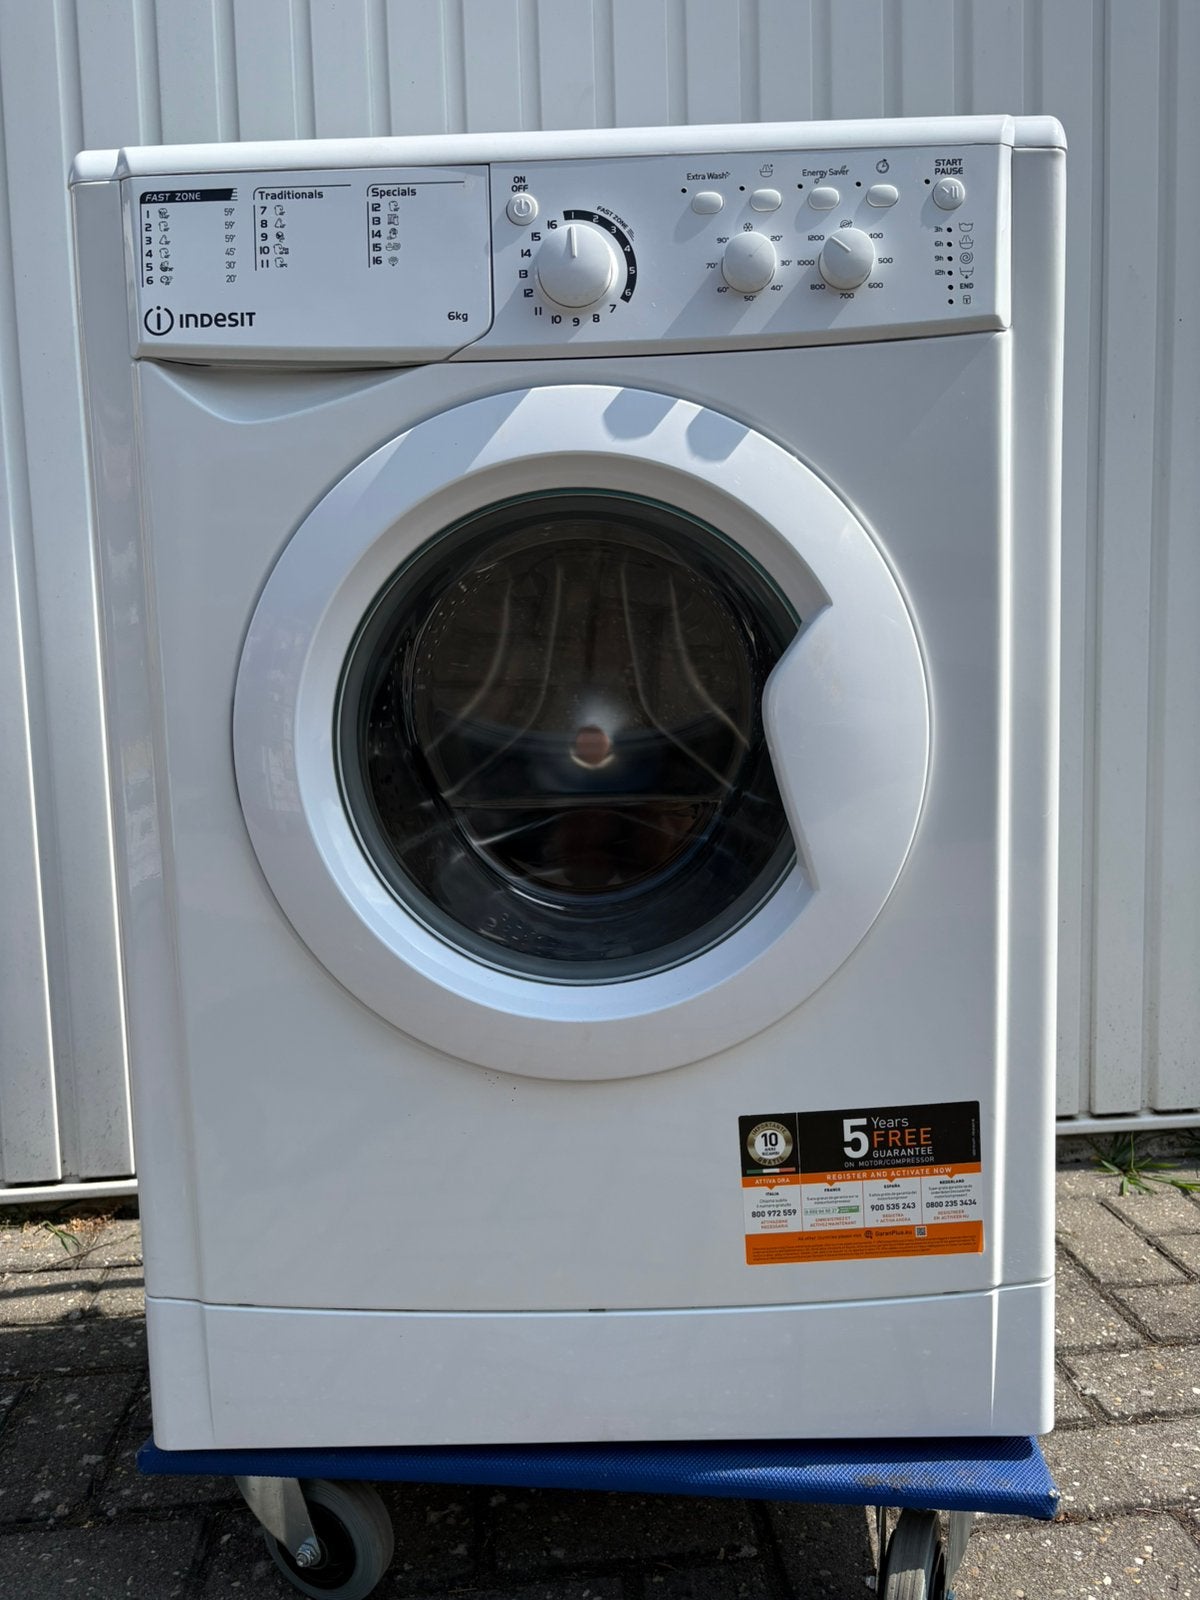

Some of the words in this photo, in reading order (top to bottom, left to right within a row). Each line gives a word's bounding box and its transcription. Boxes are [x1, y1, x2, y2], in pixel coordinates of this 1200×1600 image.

[935, 159, 963, 167] START
[802, 169, 827, 178] Energy
[829, 167, 849, 176] Saver
[935, 167, 963, 175] PAUSE
[707, 172, 727, 180] Wash
[145, 193, 169, 202] FAST
[175, 192, 200, 201] ZONE
[258, 190, 324, 200] Traditionals
[371, 187, 417, 199] Specials
[260, 206, 267, 214] 7
[372, 203, 381, 211] 12
[146, 210, 150, 218] 1
[597, 206, 613, 218] FAST
[612, 213, 628, 230] ZONE
[260, 220, 268, 228] 8
[372, 217, 380, 225] 13
[547, 220, 557, 229] 16
[372, 230, 381, 238] 14
[611, 226, 616, 234] 3
[261, 233, 268, 241] 9
[531, 232, 541, 241] 15
[145, 237, 152, 245] 3
[260, 246, 270, 255] 10
[372, 243, 382, 251] 15
[145, 250, 153, 258] 4
[521, 249, 531, 257] 14
[261, 260, 269, 268] 11
[372, 256, 382, 265] 16
[146, 263, 153, 271] 5
[519, 270, 528, 278] 13
[146, 276, 153, 284] 6
[524, 289, 533, 297] 12
[535, 307, 542, 315] 11
[610, 304, 616, 313] 7
[448, 311, 468, 322] 6kg
[552, 315, 561, 324] 10
[593, 314, 600, 322] 8
[573, 318, 580, 326] 9
[871, 1117, 909, 1129] Years
[761, 1132, 778, 1147] 10
[843, 1118, 869, 1159] 5
[873, 1128, 932, 1148] FREE
[873, 1147, 933, 1158] GUARANTEE
[859, 1157, 934, 1167] MOTOR/COMPRESSOR
[826, 1171, 868, 1181] REGISTER
[890, 1168, 930, 1177] ACTIVATE
[933, 1166, 952, 1174] NOW
